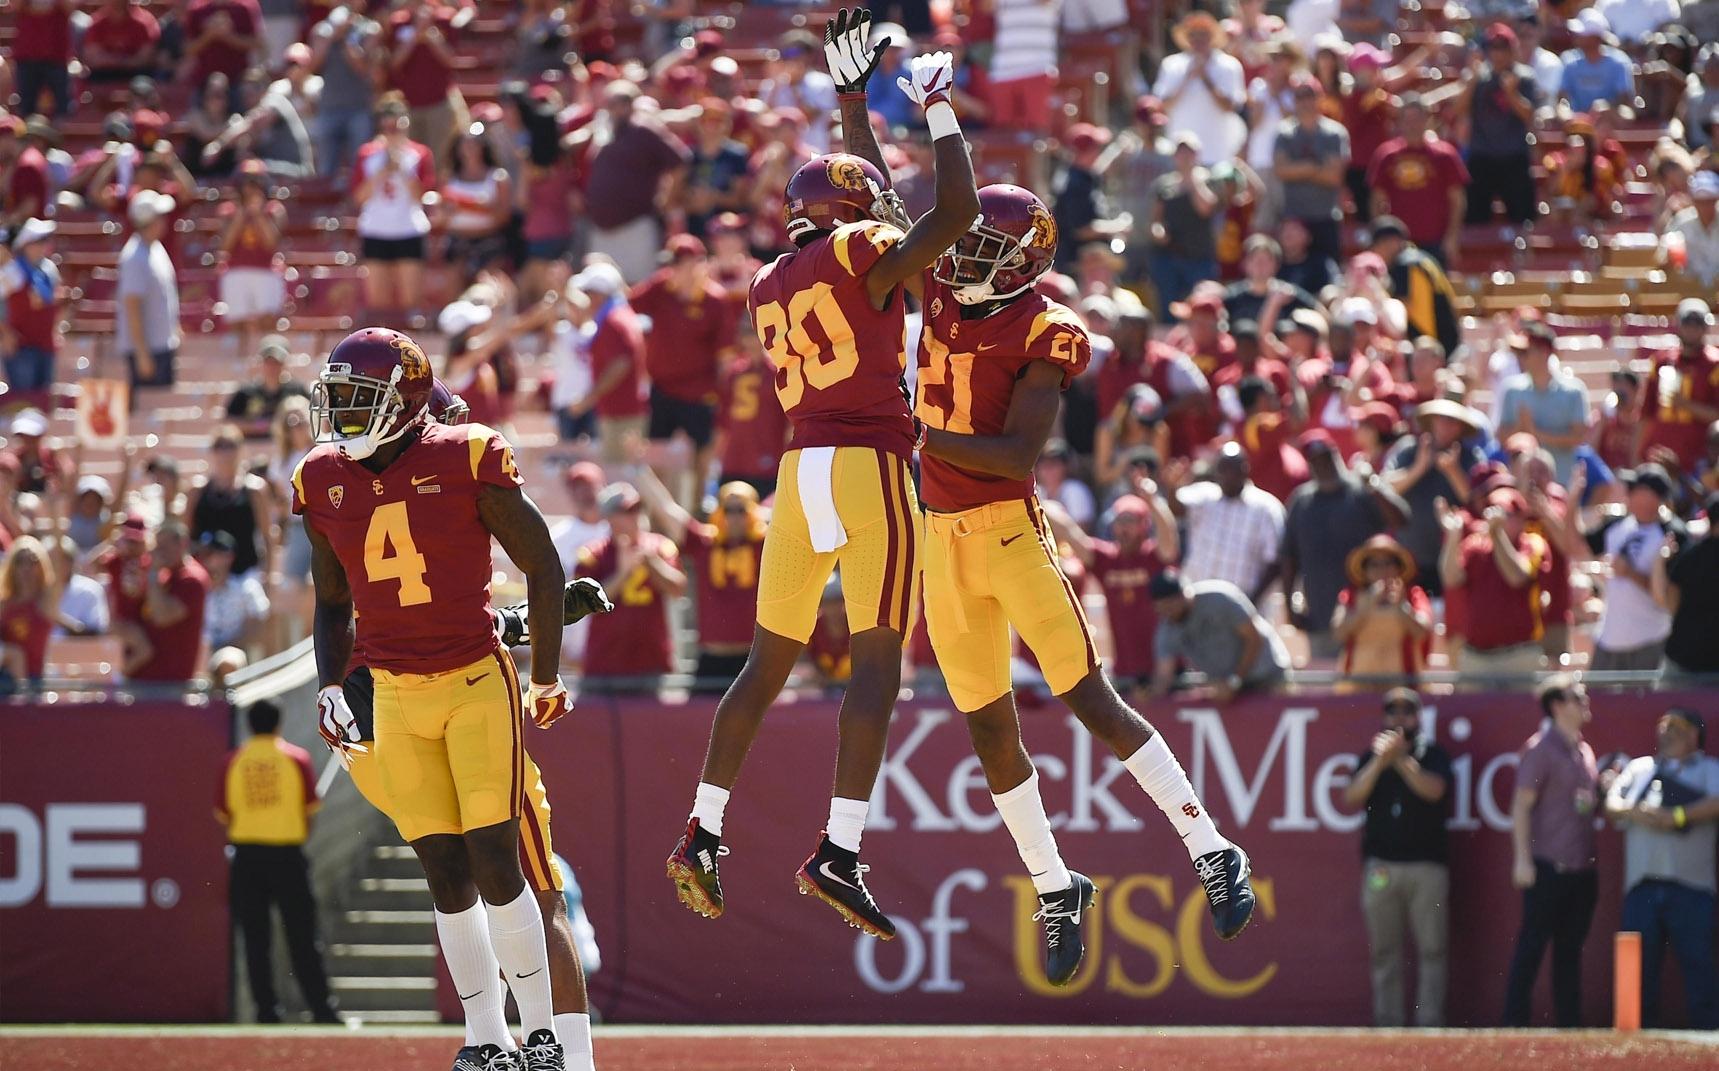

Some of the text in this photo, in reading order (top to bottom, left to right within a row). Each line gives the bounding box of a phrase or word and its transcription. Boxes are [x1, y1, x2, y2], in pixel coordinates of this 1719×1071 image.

[913, 325, 976, 435] 21
[1050, 331, 1083, 364] 21
[364, 501, 432, 607] 4
[697, 848, 714, 875] NIKE
[854, 868, 1279, 998] of USC
